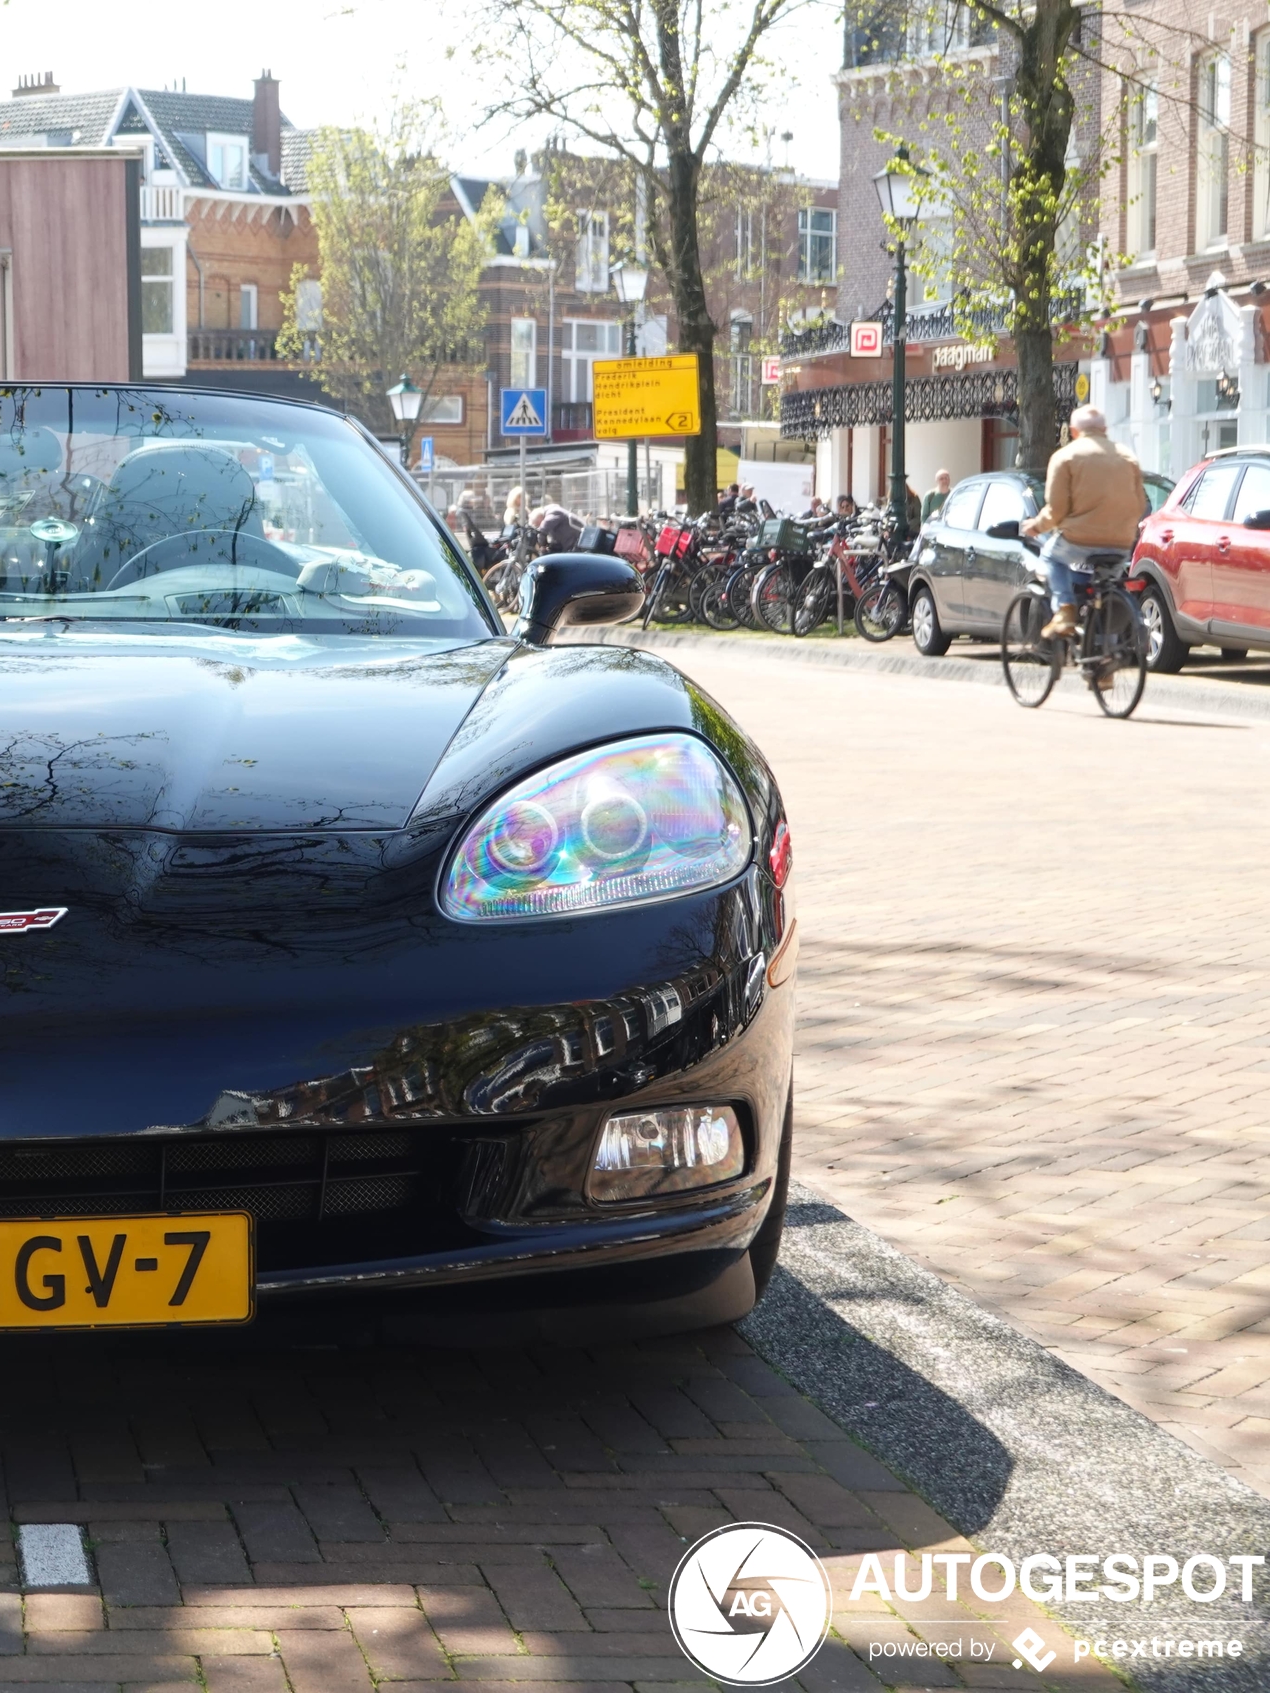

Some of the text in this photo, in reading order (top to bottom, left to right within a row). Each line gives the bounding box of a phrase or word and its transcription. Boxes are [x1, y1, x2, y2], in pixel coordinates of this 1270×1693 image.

[932, 343, 994, 374] paagman
[616, 360, 673, 369] omleiding
[595, 380, 661, 389] Hendrikplein
[595, 391, 621, 399] dicht
[596, 408, 645, 416] President
[596, 416, 662, 426] Kennedylaan
[677, 415, 688, 428] 2
